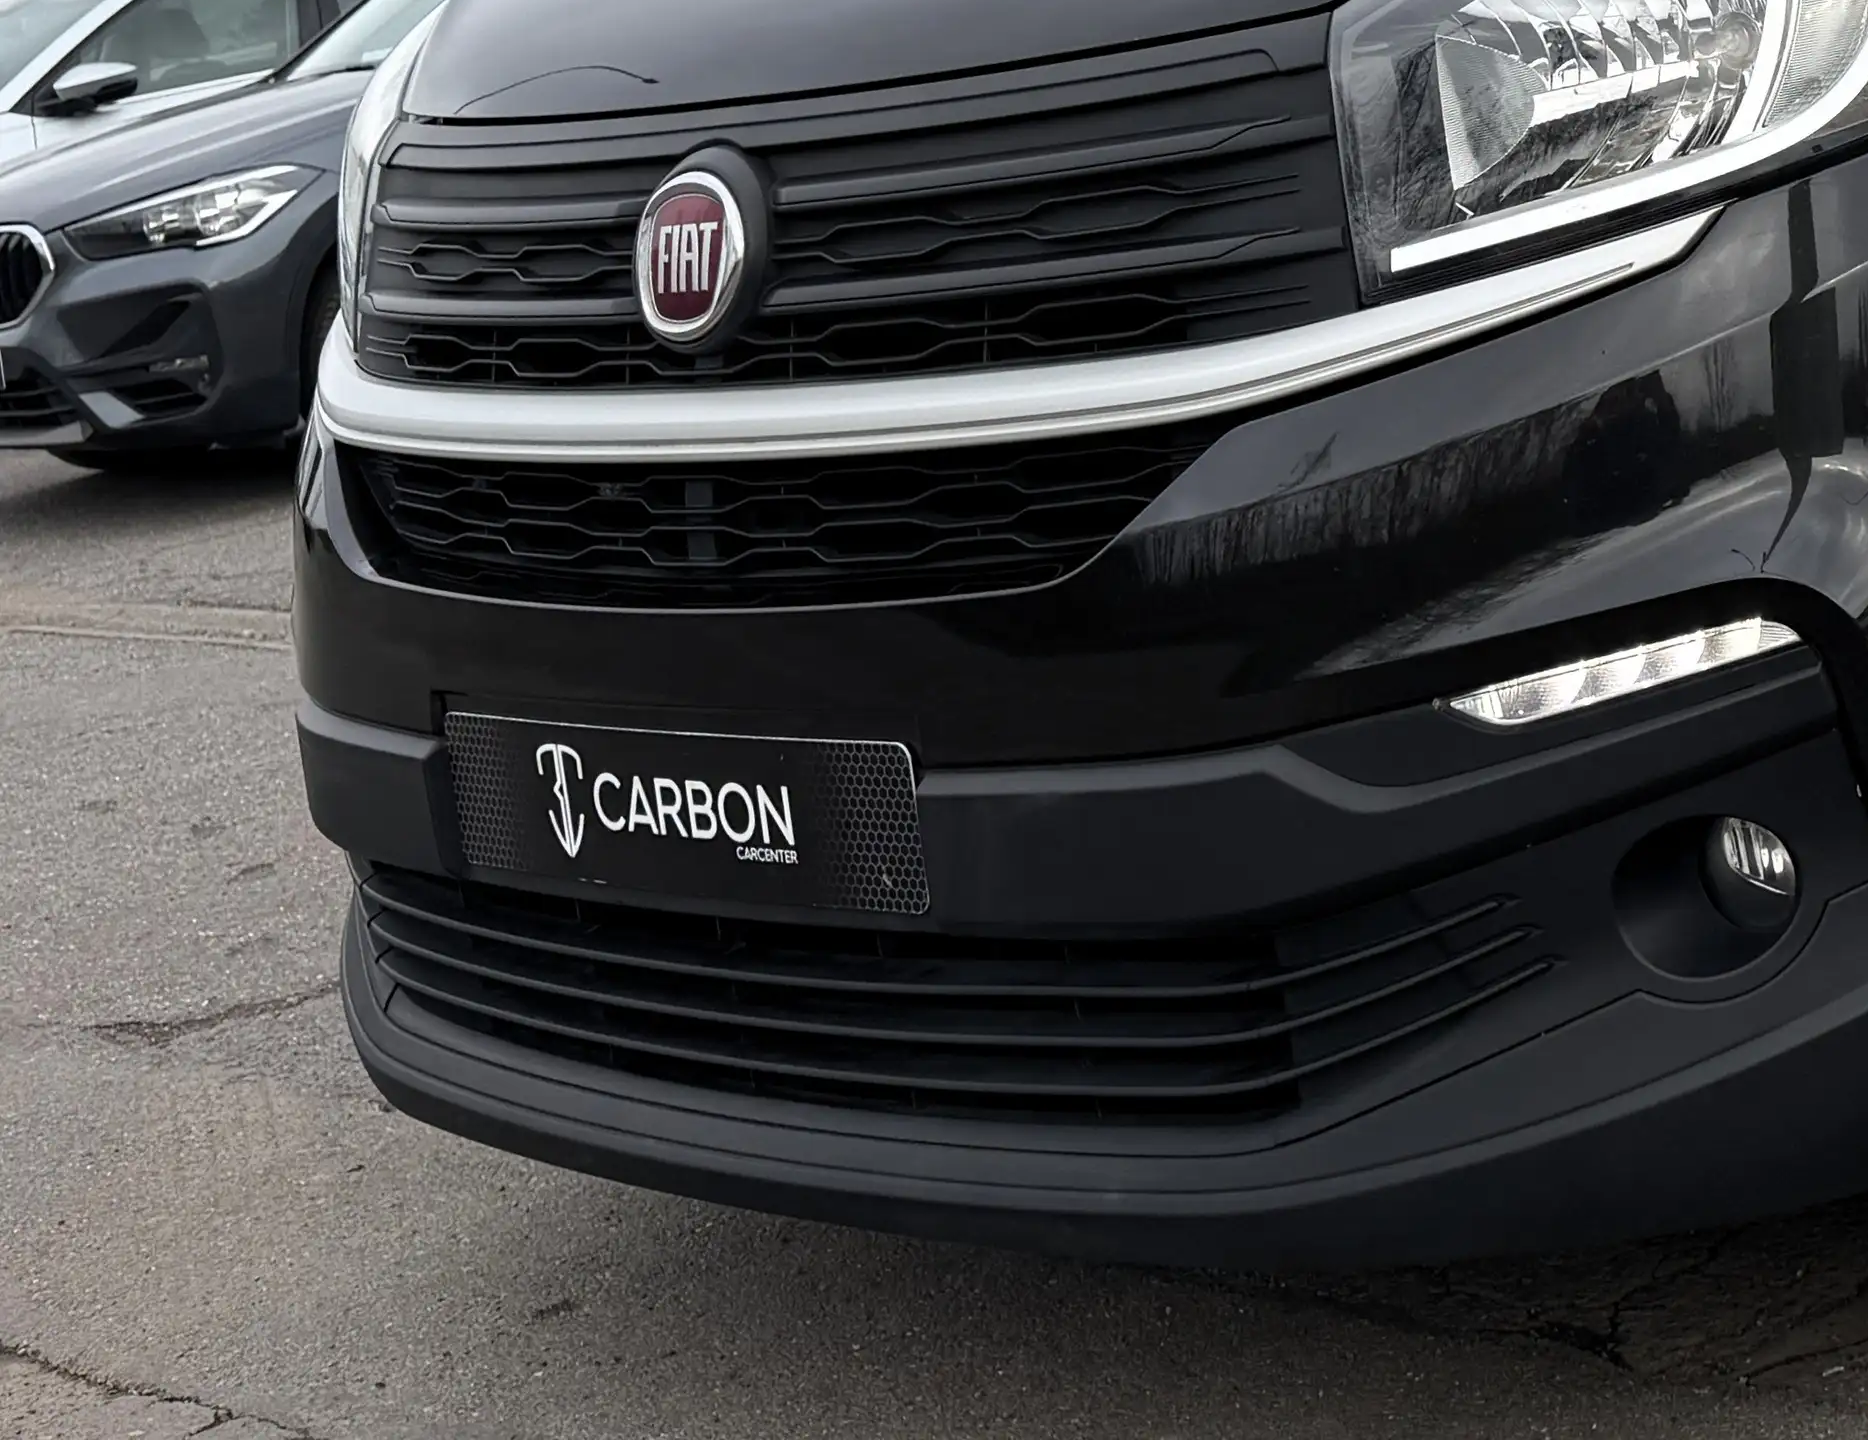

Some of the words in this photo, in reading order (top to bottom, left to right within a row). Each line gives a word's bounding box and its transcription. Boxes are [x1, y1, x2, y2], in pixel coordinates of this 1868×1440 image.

[658, 221, 718, 294] FIAT
[593, 772, 795, 846] CARBON
[736, 846, 799, 865] CARCENTER
